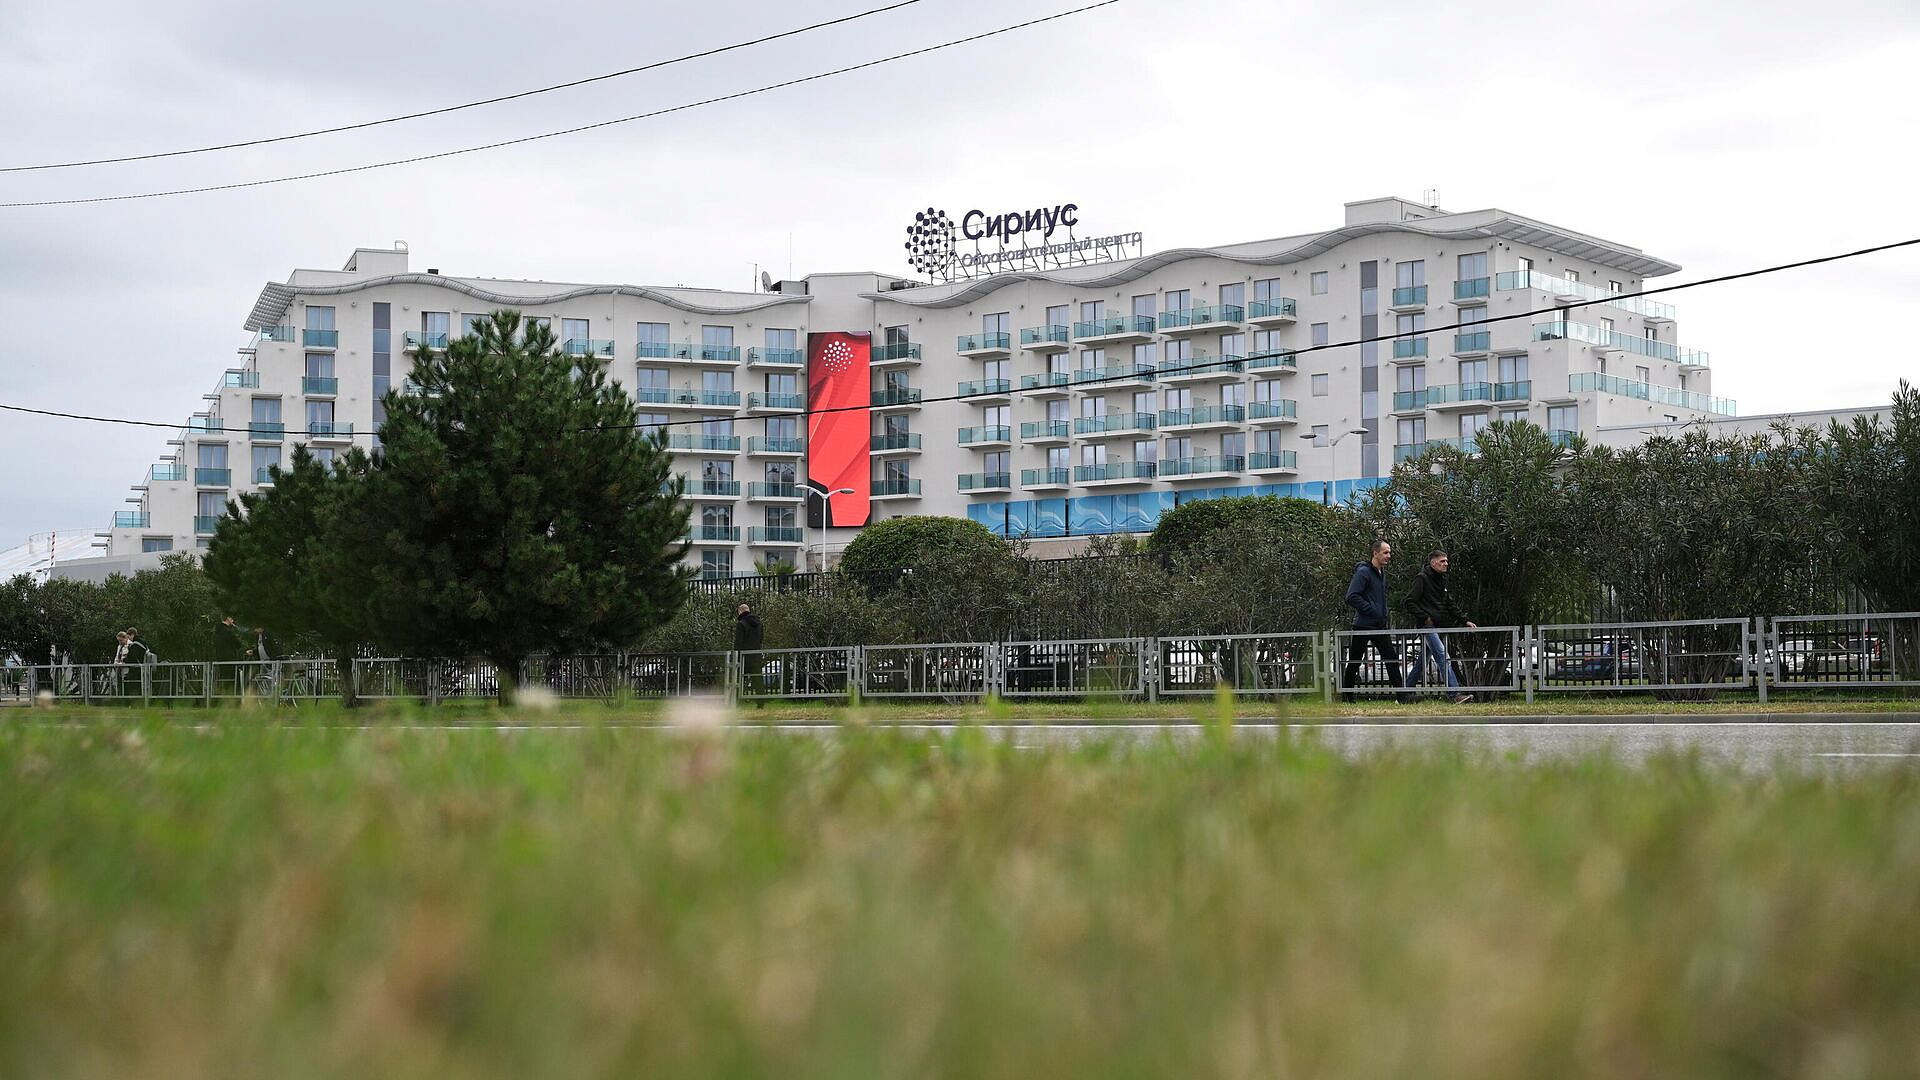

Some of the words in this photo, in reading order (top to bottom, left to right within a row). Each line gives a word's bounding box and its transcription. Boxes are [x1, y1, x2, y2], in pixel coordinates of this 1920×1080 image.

[962, 203, 1079, 243] Сириус
[961, 236, 1092, 268] Образовательный
[1095, 231, 1142, 249] центр
